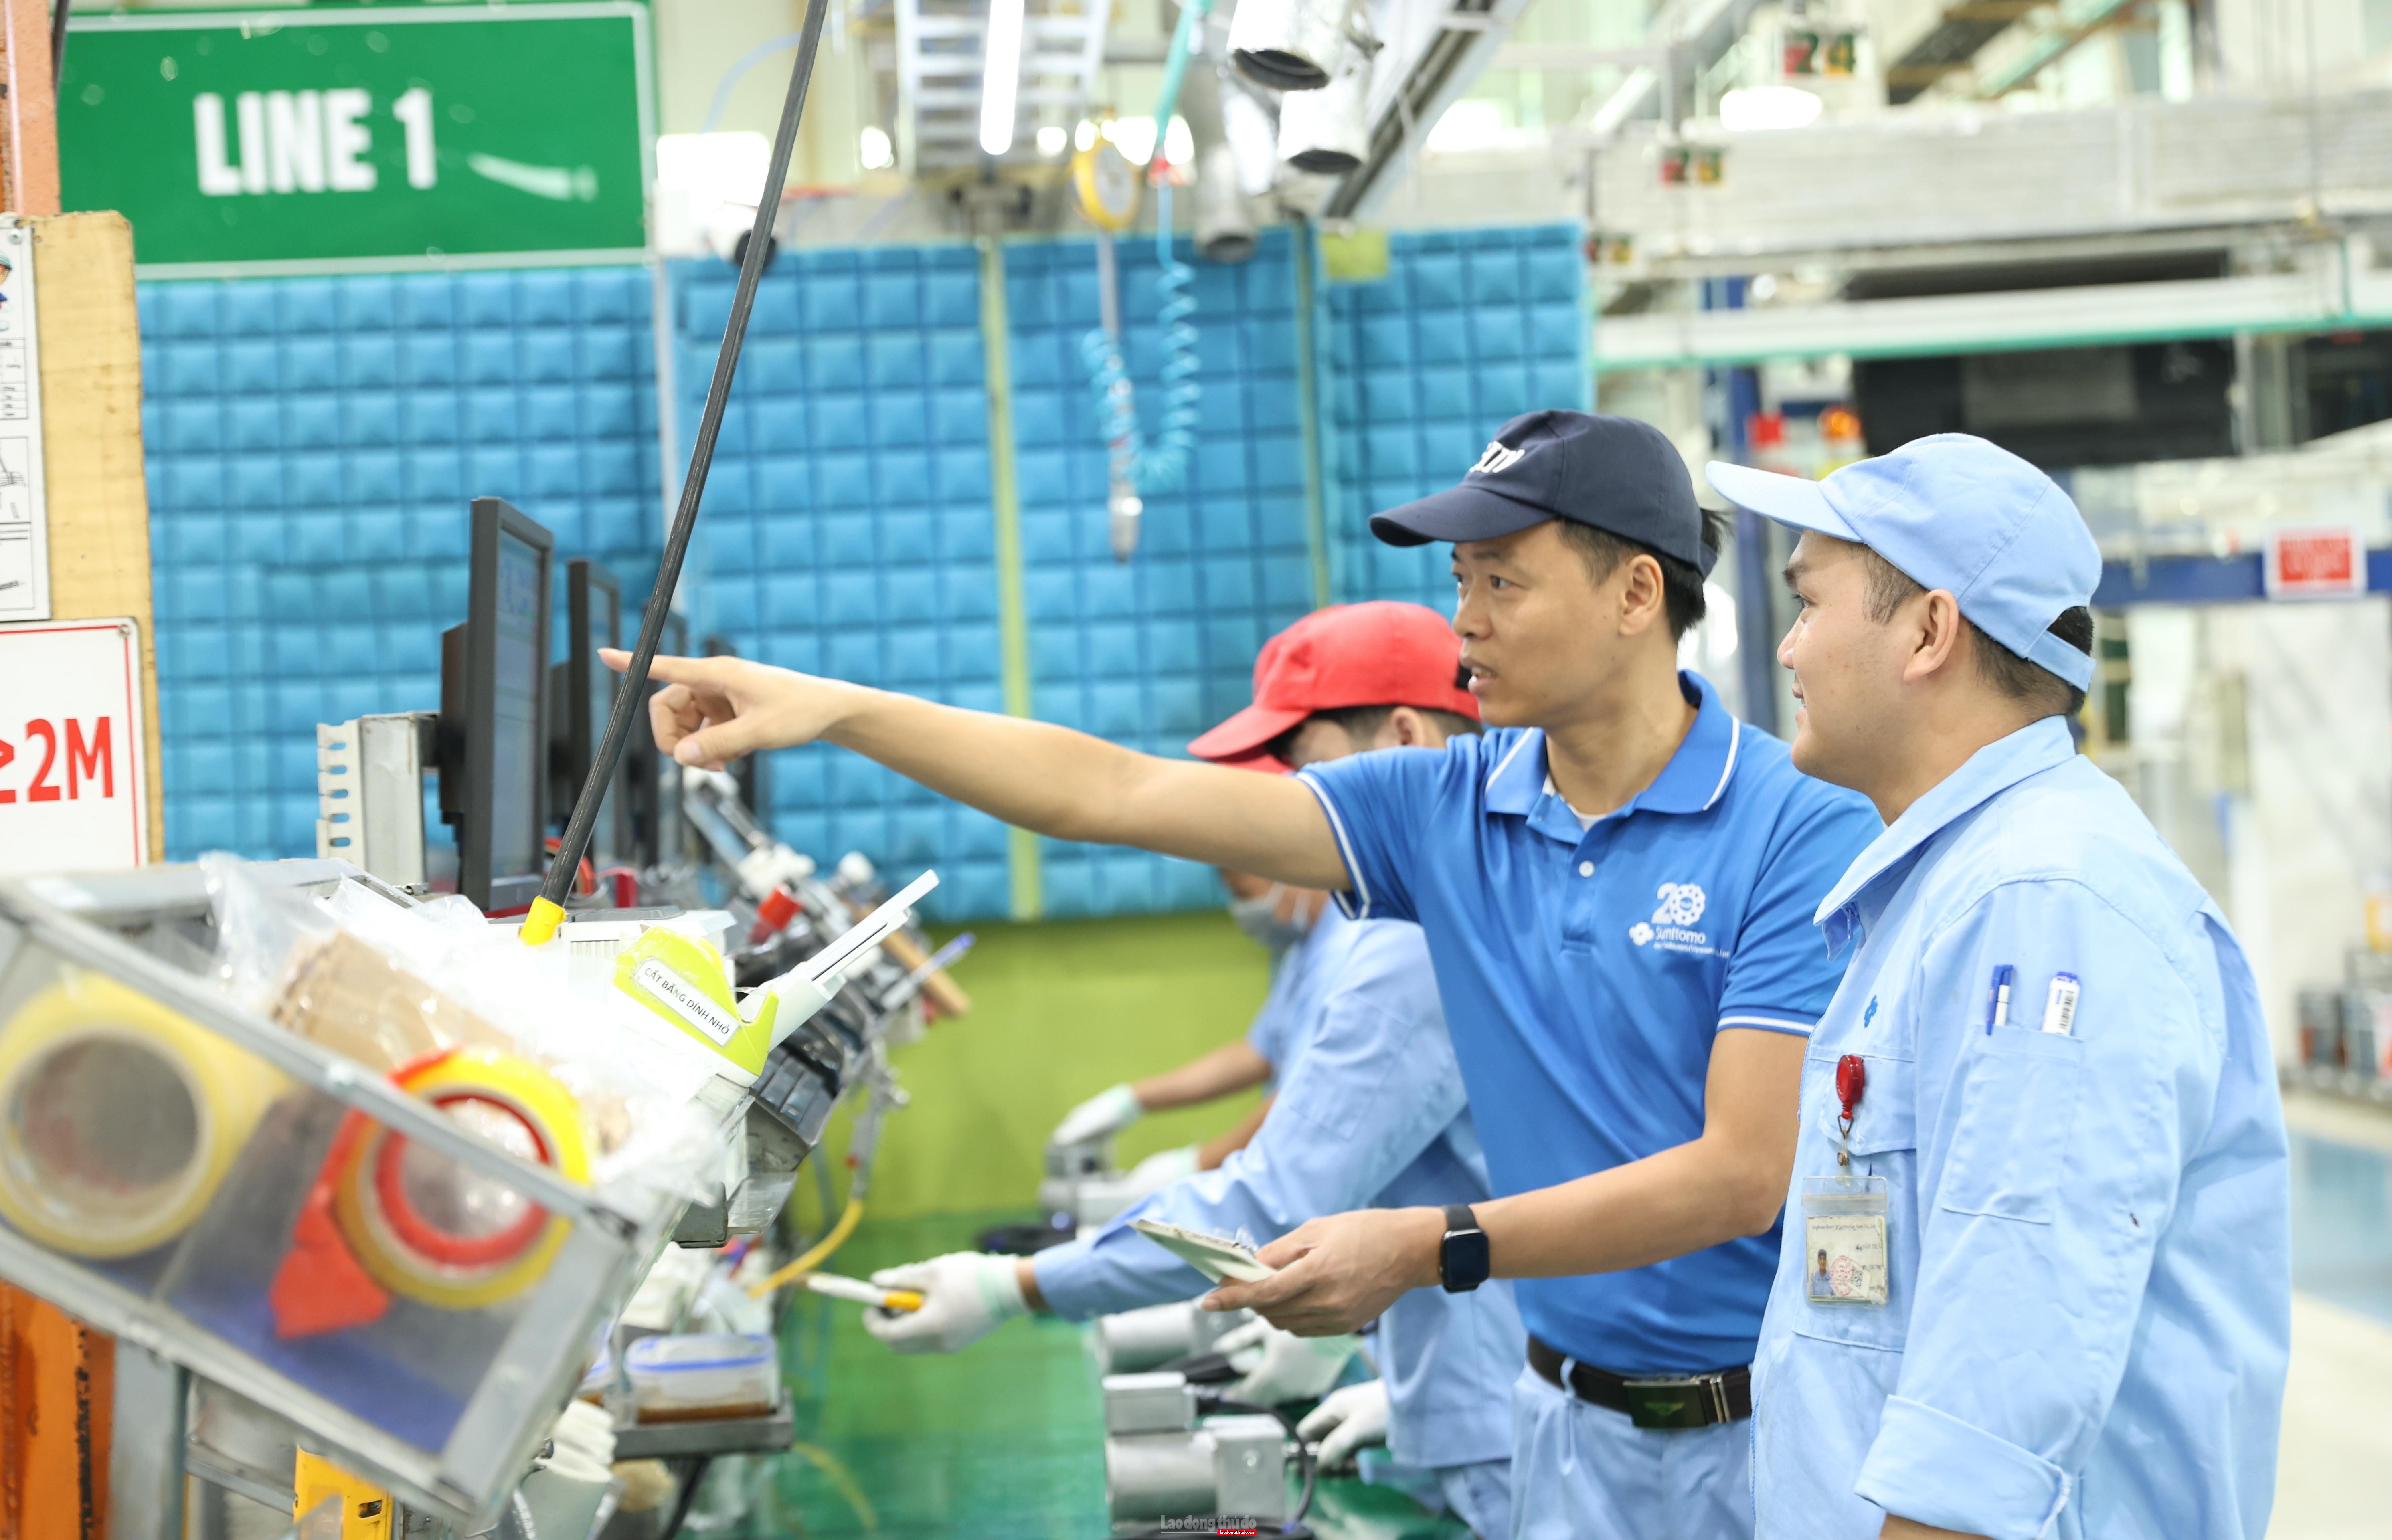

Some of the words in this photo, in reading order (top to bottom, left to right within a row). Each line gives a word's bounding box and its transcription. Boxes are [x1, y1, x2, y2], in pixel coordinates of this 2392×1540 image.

[193, 88, 378, 196] LINE
[393, 87, 437, 190] 1
[644, 968, 663, 982] CẮT
[662, 980, 687, 1002] BĂNG
[687, 999, 710, 1020] DÍNH
[709, 1017, 729, 1034] NHỎ
